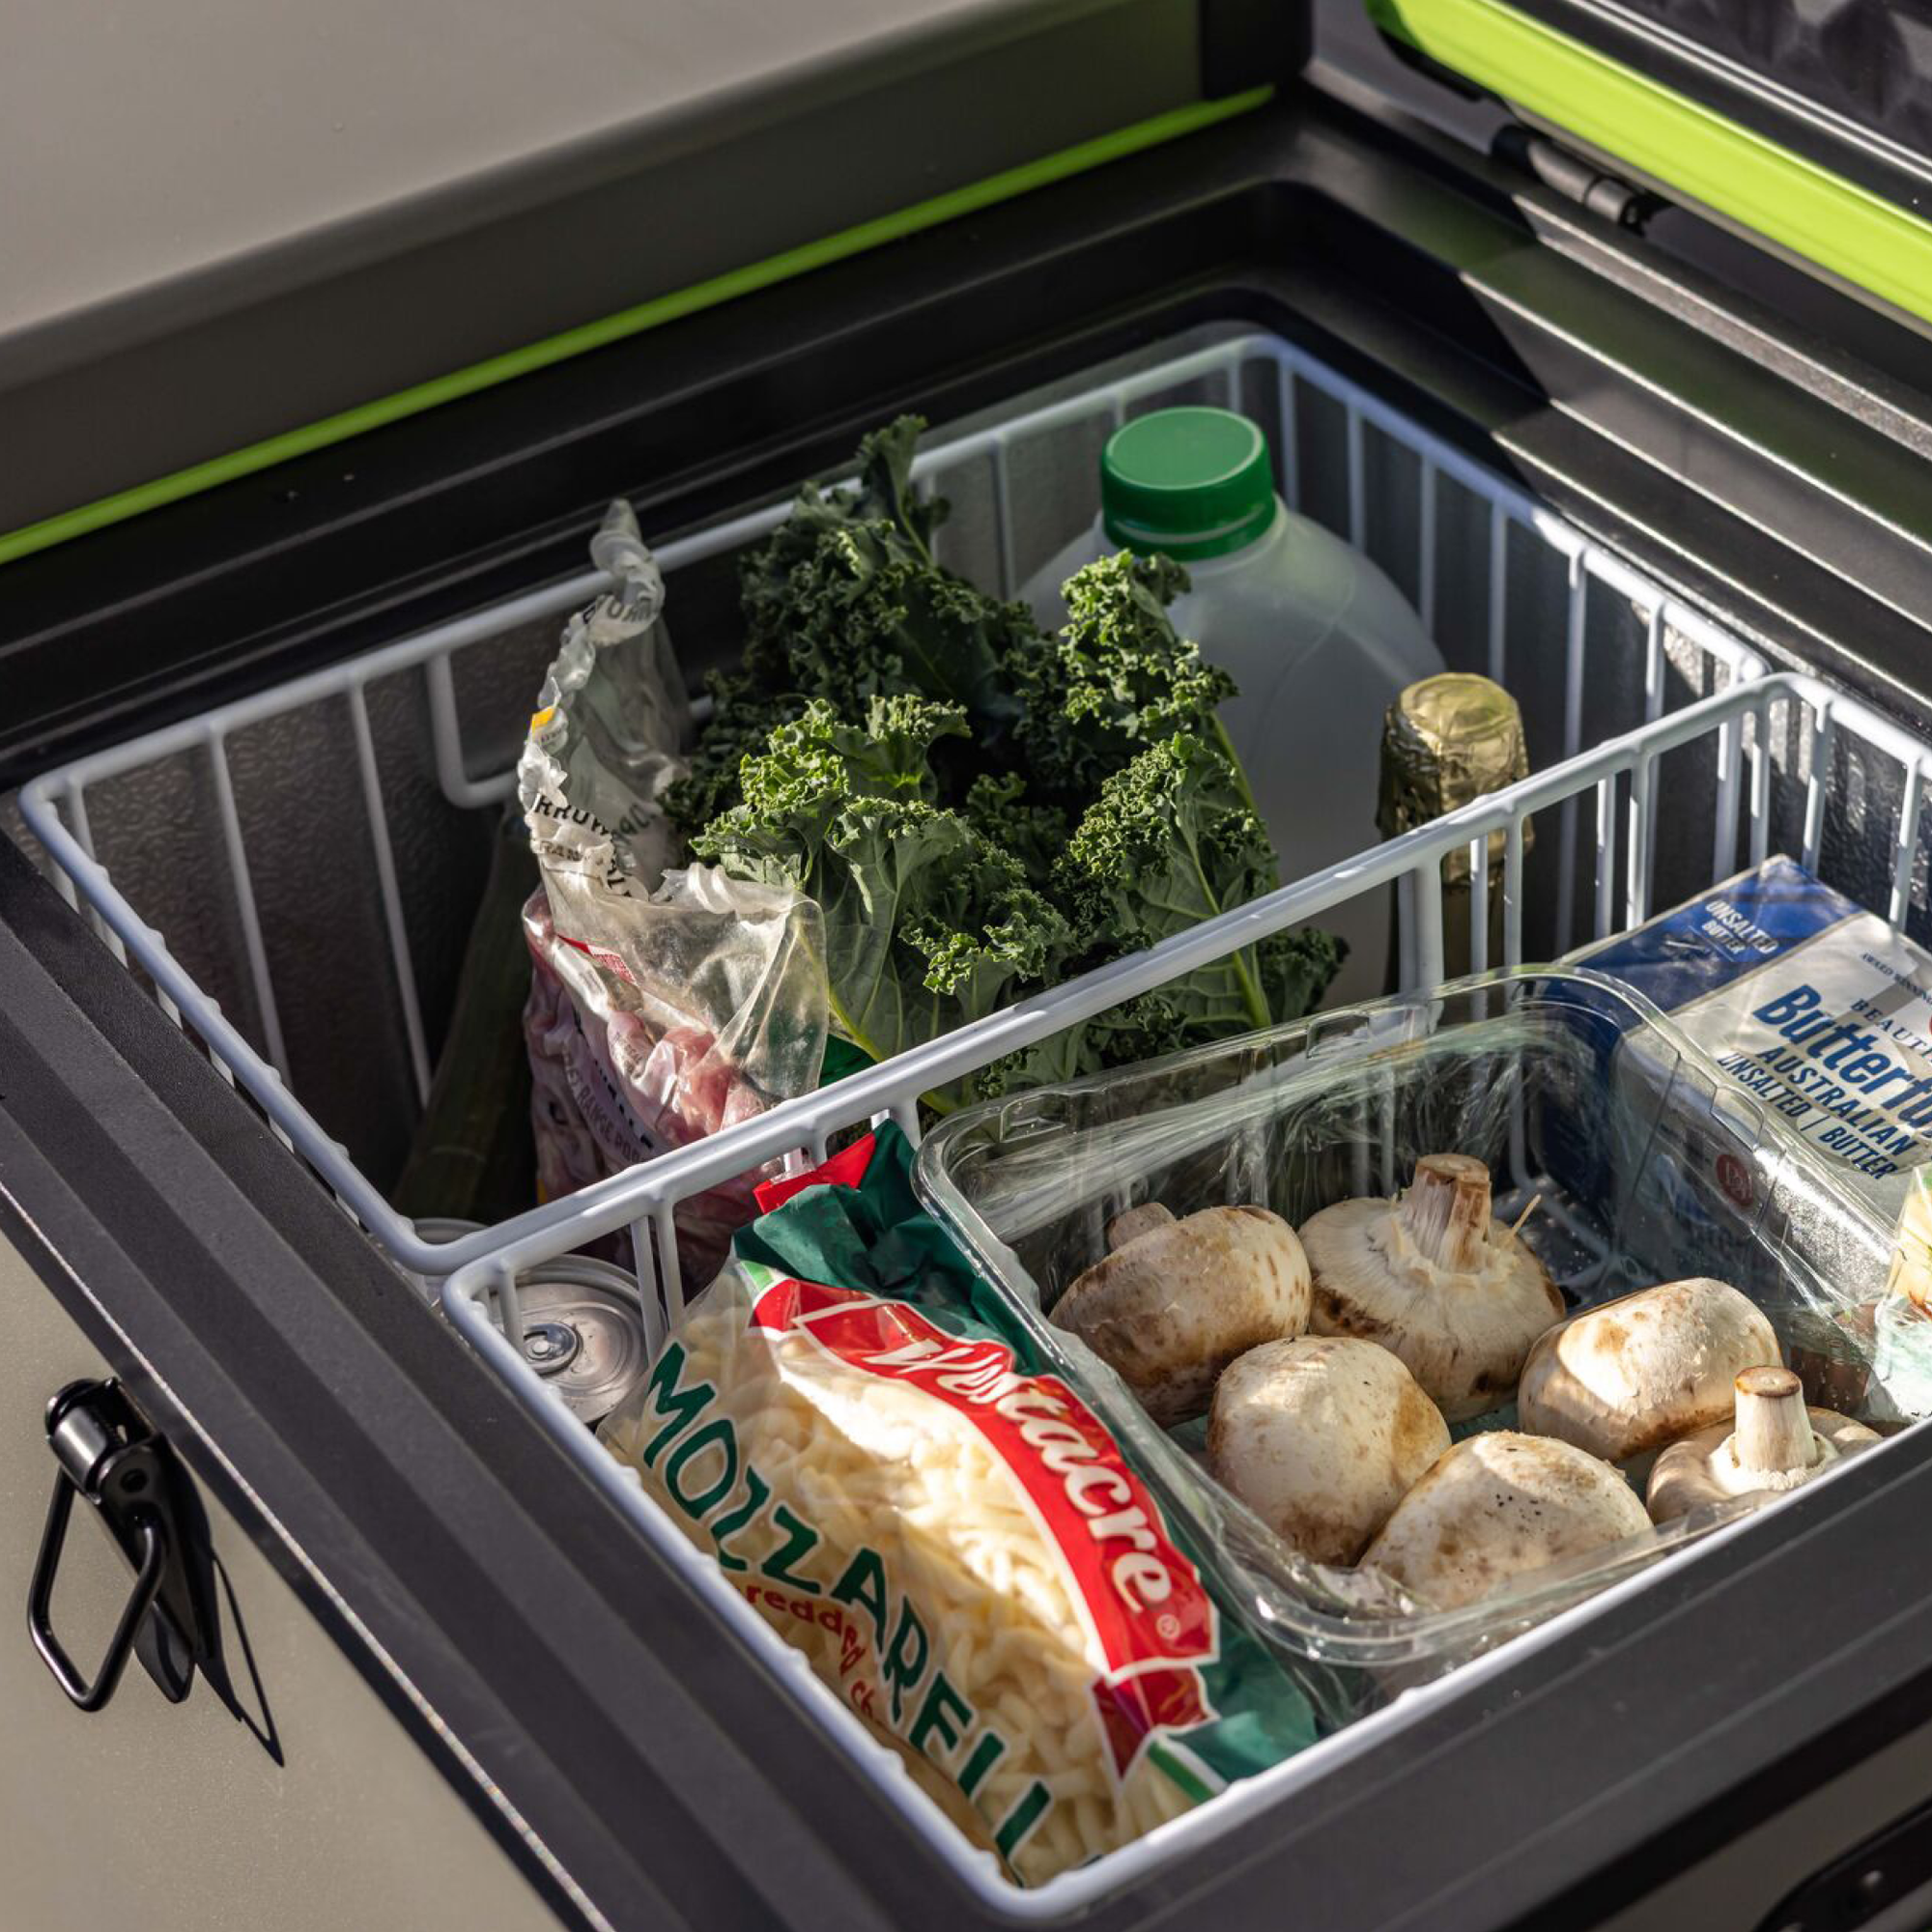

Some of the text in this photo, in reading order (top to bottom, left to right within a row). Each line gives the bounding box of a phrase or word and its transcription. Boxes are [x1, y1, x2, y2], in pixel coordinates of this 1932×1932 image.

[1701, 920, 1747, 955] BUTTER
[1705, 899, 1779, 954] UNSALTED
[1717, 1052, 1899, 1179] UNSALTED BUTTER
[1752, 983, 1932, 1138] Butterfu
[1756, 1045, 1919, 1156] AUSTRALIAN
[861, 1338, 1173, 1615] Westacre
